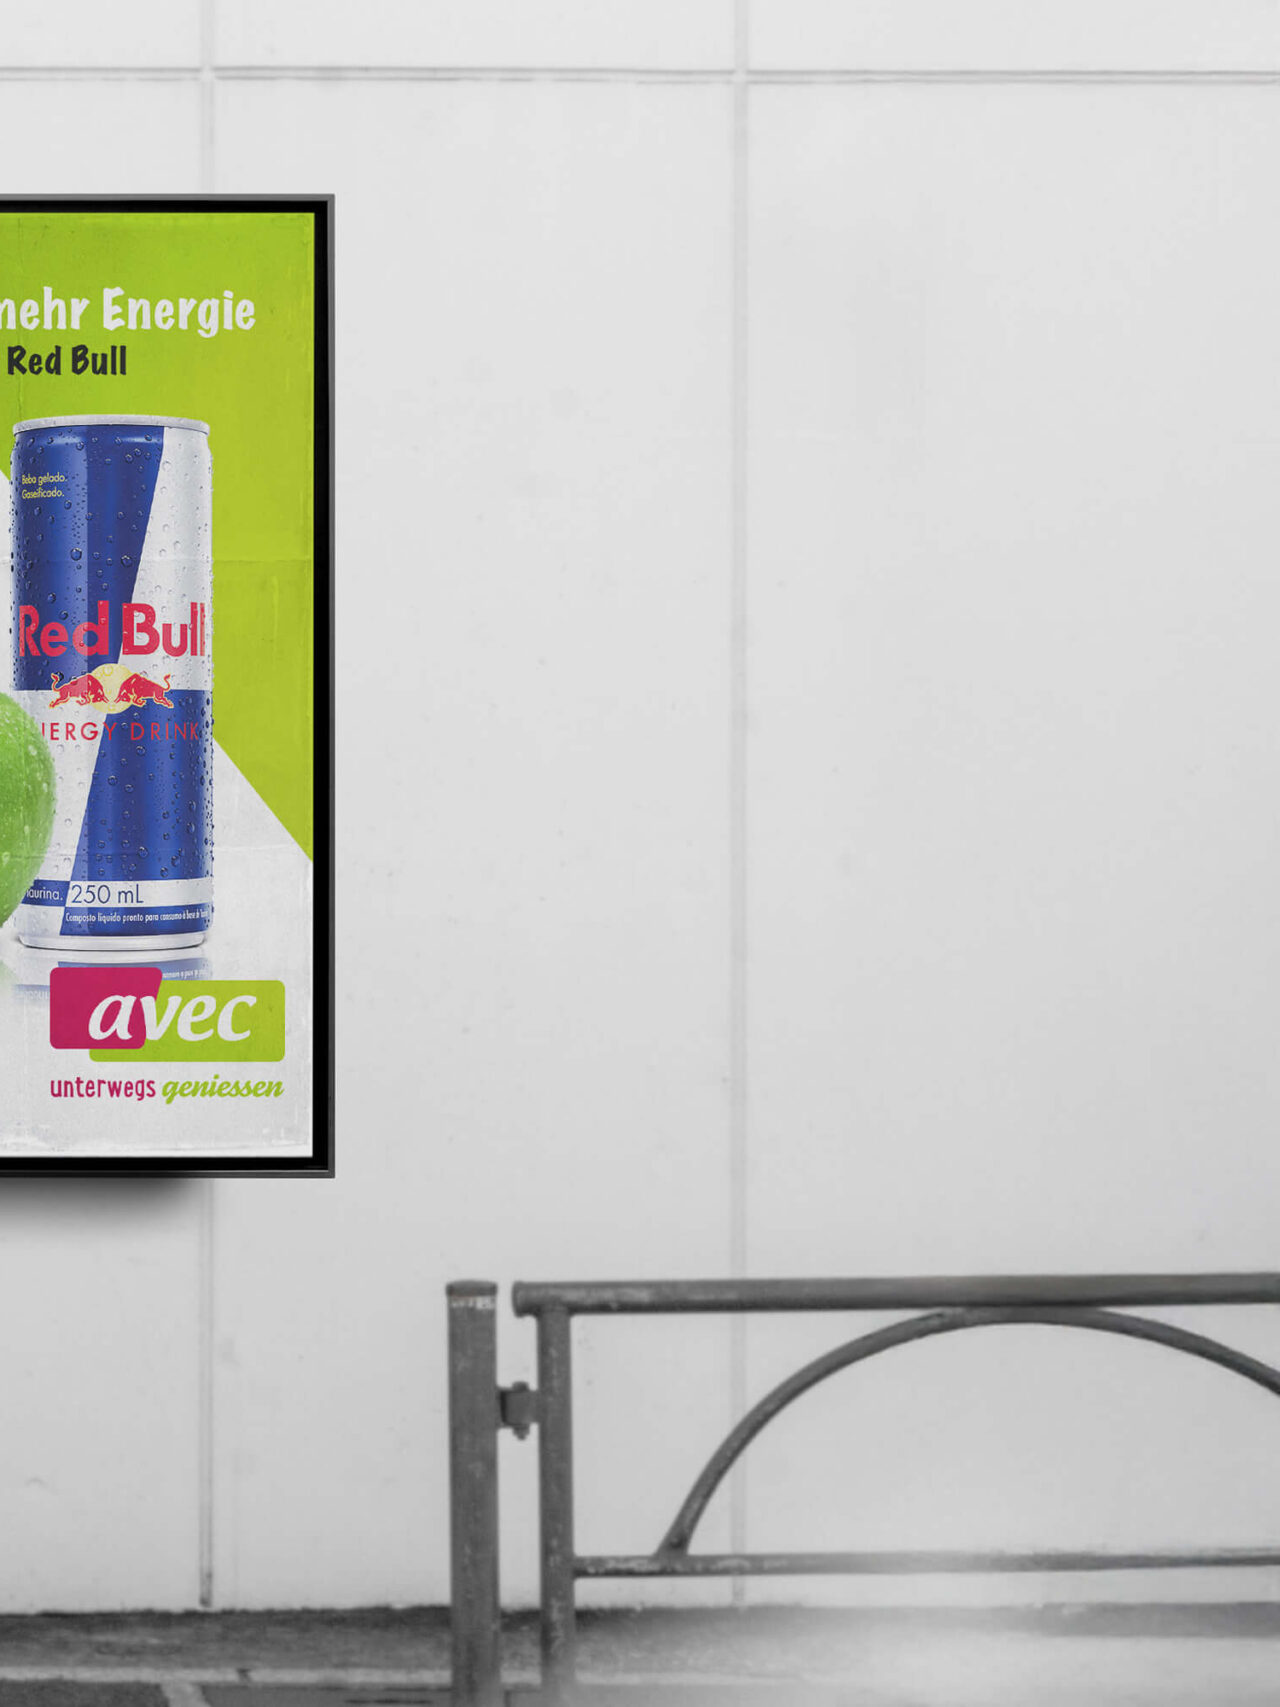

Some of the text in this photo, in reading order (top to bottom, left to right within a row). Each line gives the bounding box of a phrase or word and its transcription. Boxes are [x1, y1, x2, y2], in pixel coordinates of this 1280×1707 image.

[103, 286, 257, 339] Energie
[7, 344, 62, 376] Red
[71, 344, 127, 376] Bull
[18, 600, 206, 658] Red Bull
[41, 721, 200, 741] ERGY DRINK
[71, 883, 145, 904] 250 mL
[65, 912, 97, 924] Composto
[122, 912, 144, 924] pronto
[145, 913, 159, 924] para
[88, 994, 257, 1042] avec
[50, 1073, 284, 1105] unterwegs geniessen
